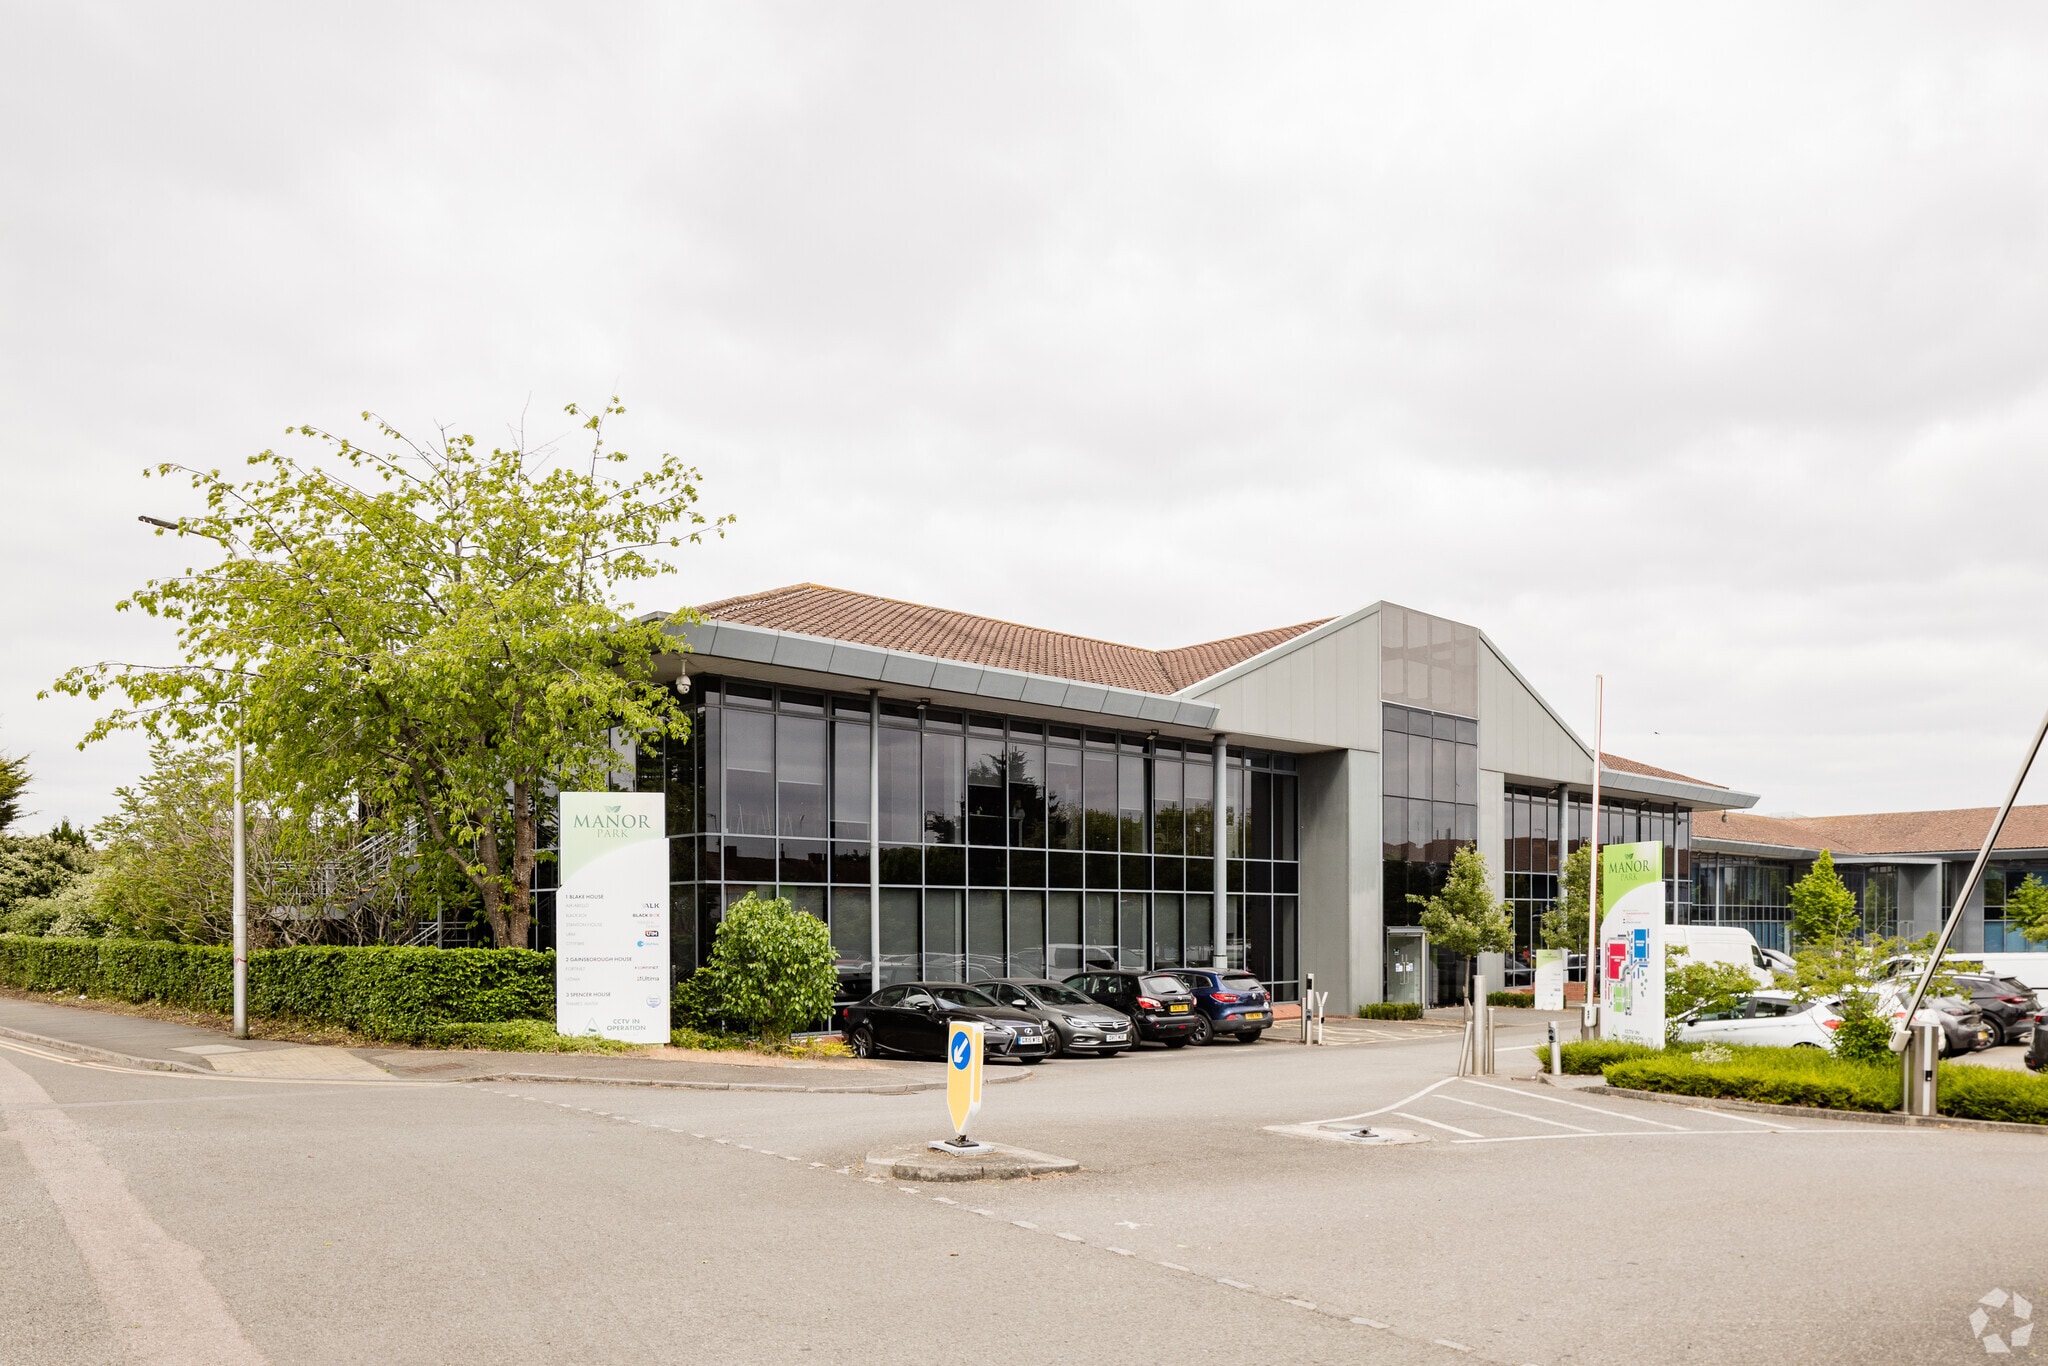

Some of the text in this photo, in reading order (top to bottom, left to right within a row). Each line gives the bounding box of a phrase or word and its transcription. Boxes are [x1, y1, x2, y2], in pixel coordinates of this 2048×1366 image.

[574, 814, 651, 829] MANOR
[597, 829, 629, 838] PARK
[1609, 859, 1650, 874] MANOR
[1620, 873, 1638, 881] PARK
[606, 1024, 646, 1032] OPERATION
